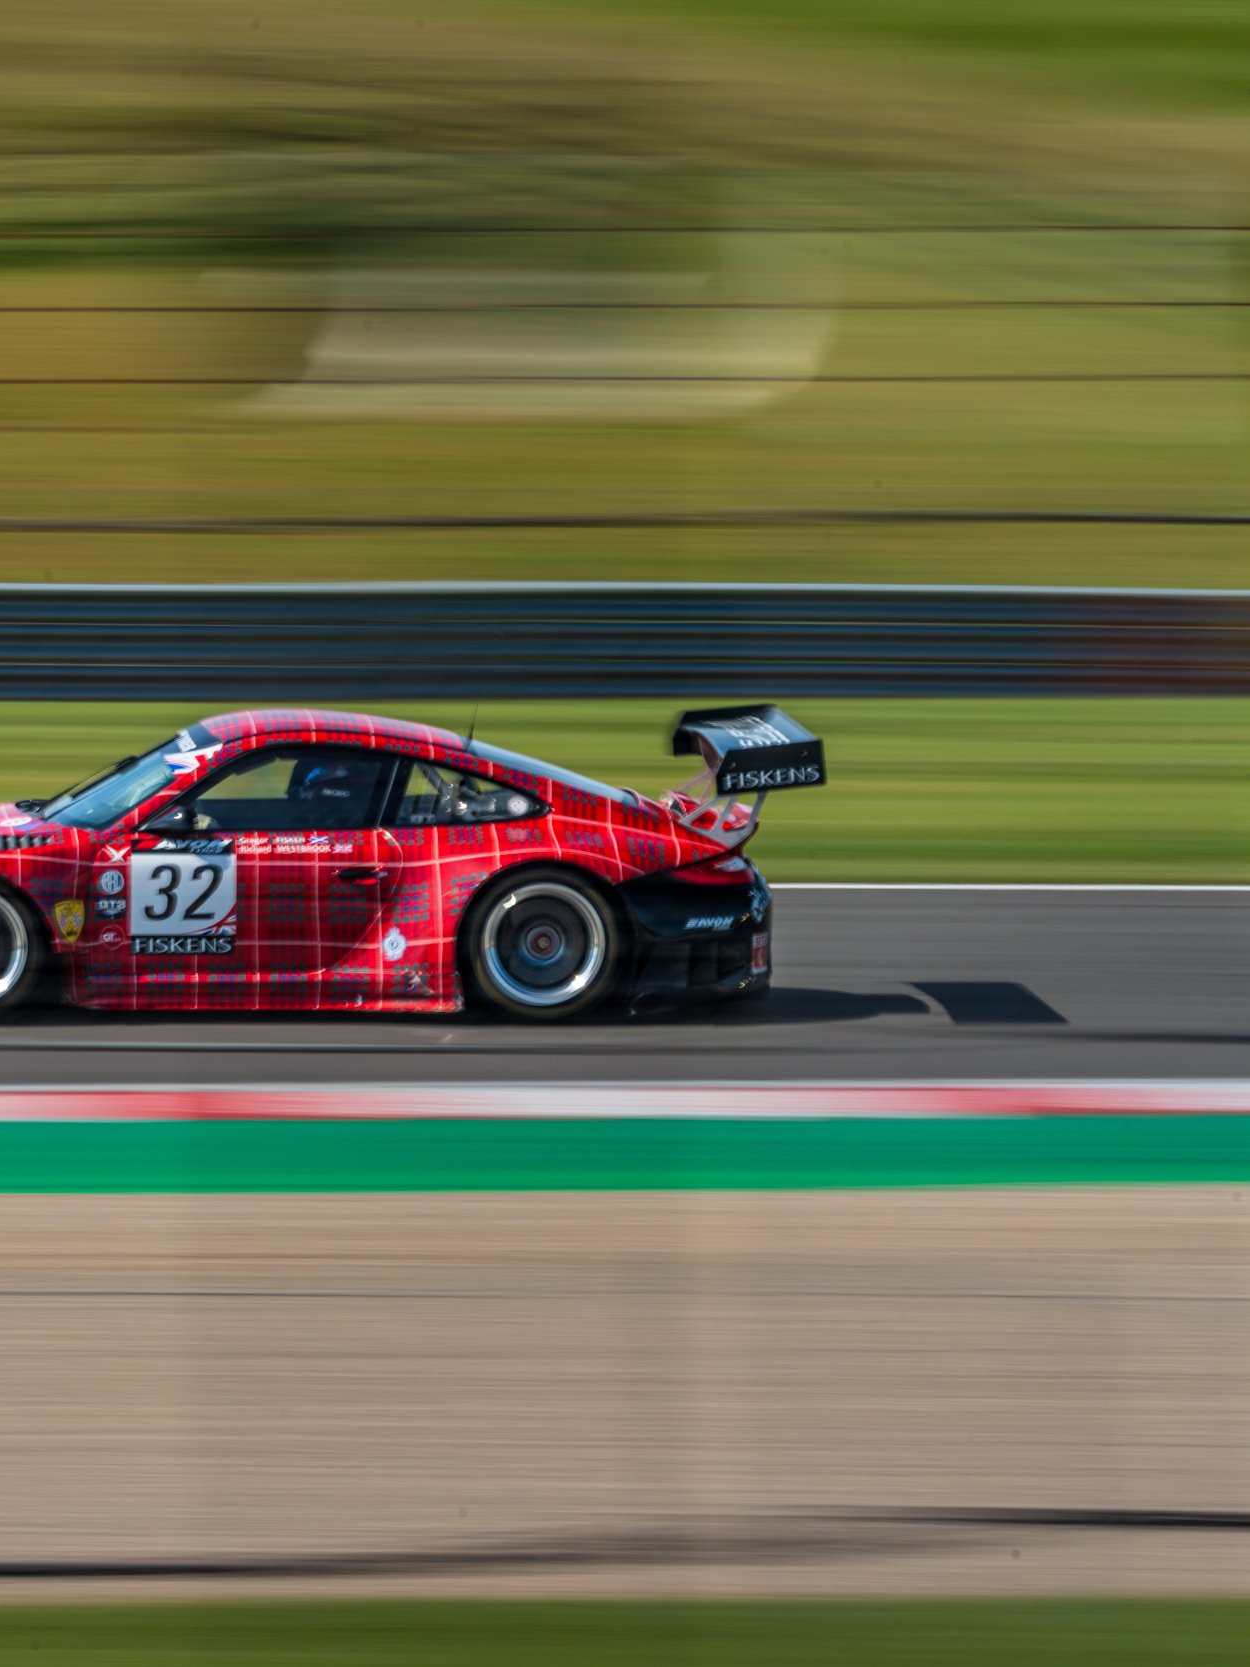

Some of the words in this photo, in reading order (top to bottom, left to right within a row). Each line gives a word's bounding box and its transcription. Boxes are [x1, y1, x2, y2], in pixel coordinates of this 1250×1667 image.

[722, 764, 820, 791] FISKENS
[275, 836, 306, 844] FISKEN
[276, 845, 332, 854] WESTBROOK
[143, 864, 225, 920] 32
[133, 938, 232, 953] FISKENS
